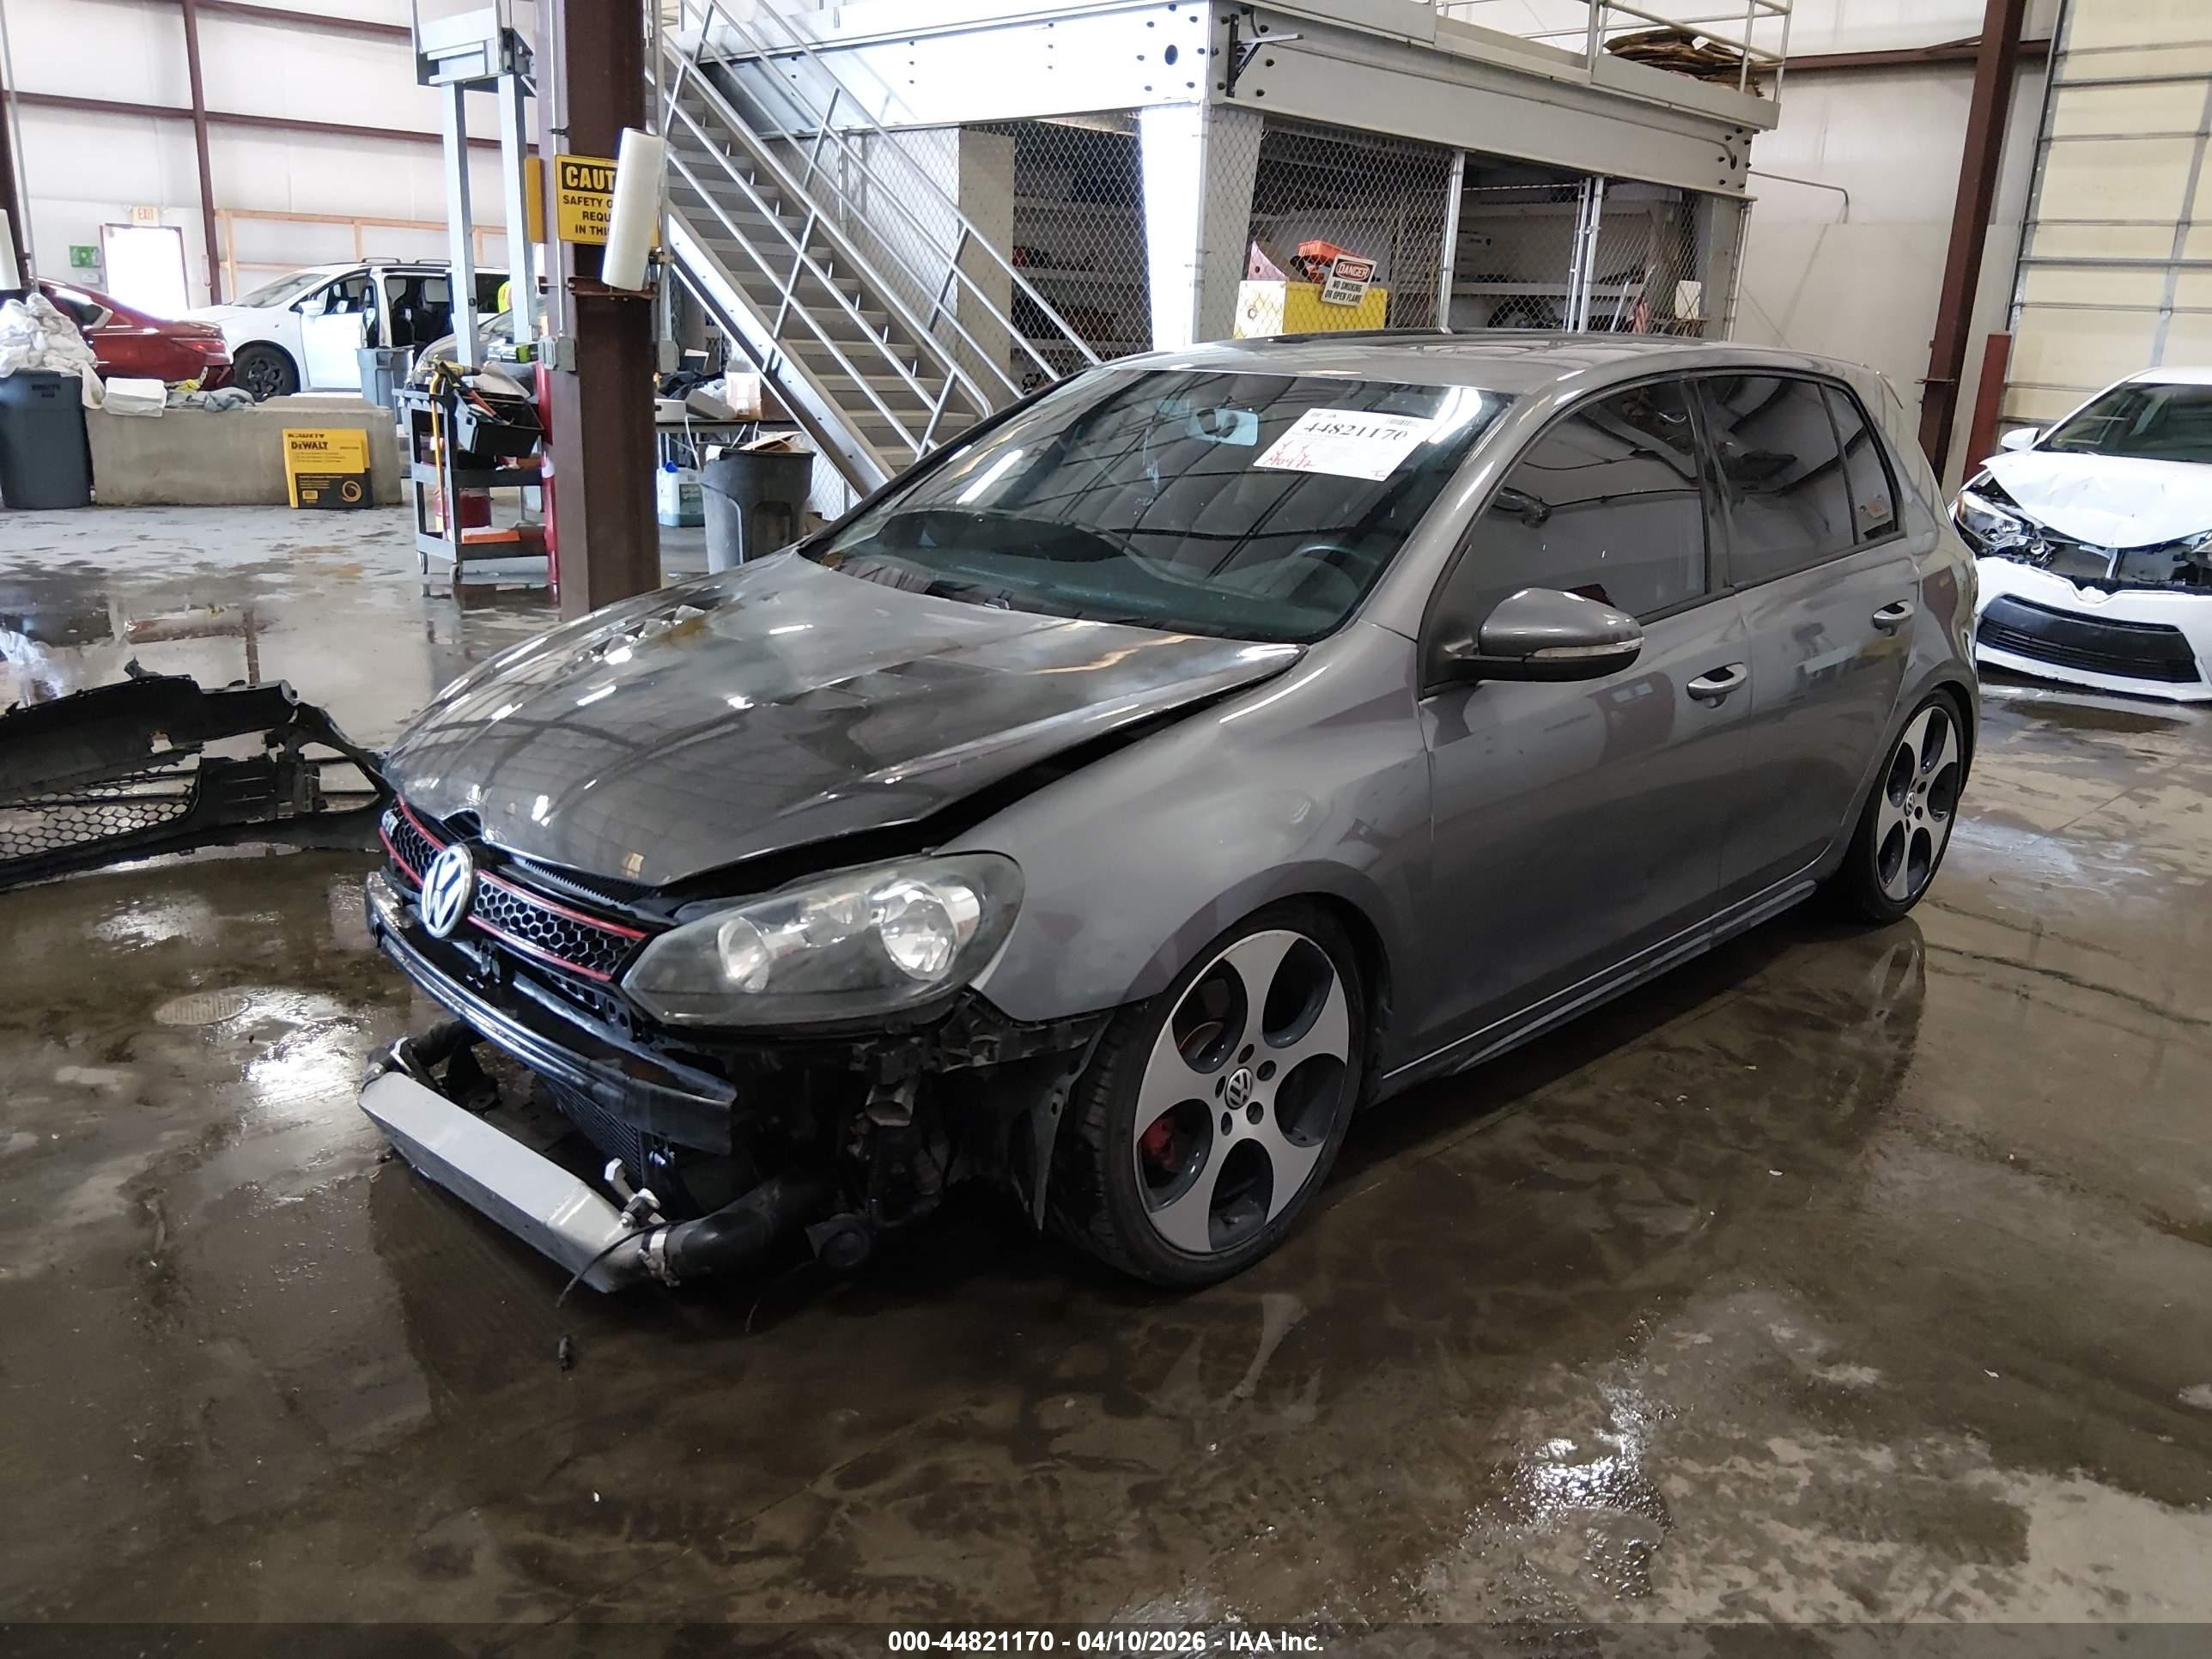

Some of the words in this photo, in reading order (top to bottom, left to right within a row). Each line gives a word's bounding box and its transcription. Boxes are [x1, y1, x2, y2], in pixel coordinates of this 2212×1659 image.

[566, 166, 616, 191] CAUT
[562, 195, 603, 208] SAFETY
[582, 211, 611, 222] REQU
[575, 224, 586, 234] IN
[590, 226, 610, 236] THI
[1338, 264, 1370, 278] DANGER
[1303, 422, 1409, 441] 44821170
